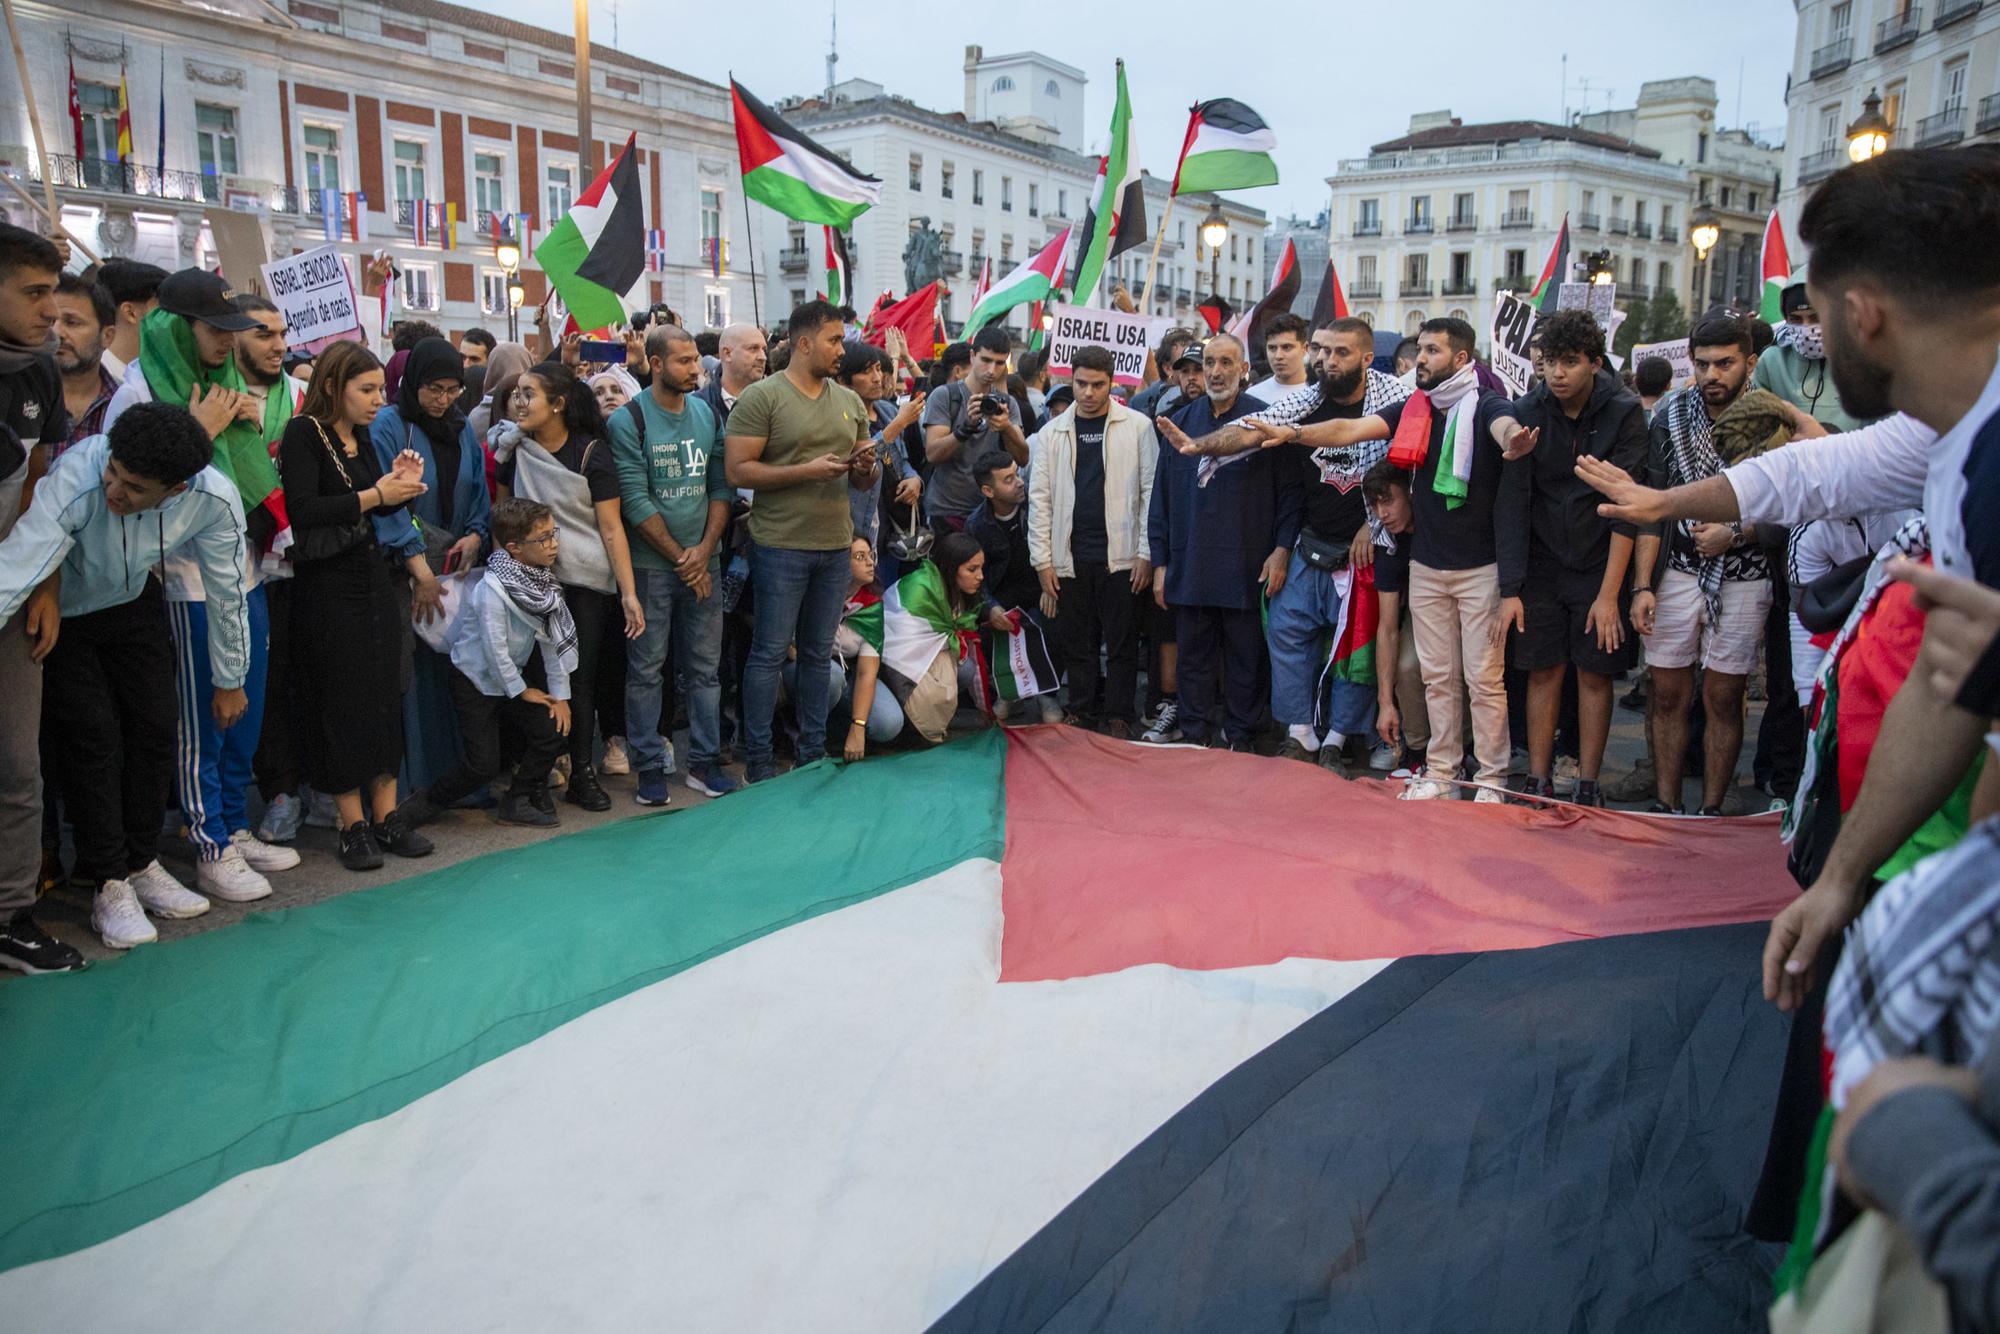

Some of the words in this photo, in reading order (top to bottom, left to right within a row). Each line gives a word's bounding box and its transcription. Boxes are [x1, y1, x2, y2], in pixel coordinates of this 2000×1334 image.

[284, 299, 318, 337] Aprendió
[318, 298, 331, 322] de
[1057, 317, 1111, 343] ISRAEL
[1116, 324, 1147, 348] USA
[1495, 349, 1526, 388] JUSTA
[652, 443, 678, 453] INDIGO
[681, 439, 708, 477] LA
[1014, 636, 1024, 674] JUSTICIA
[1022, 673, 1030, 687] YA
